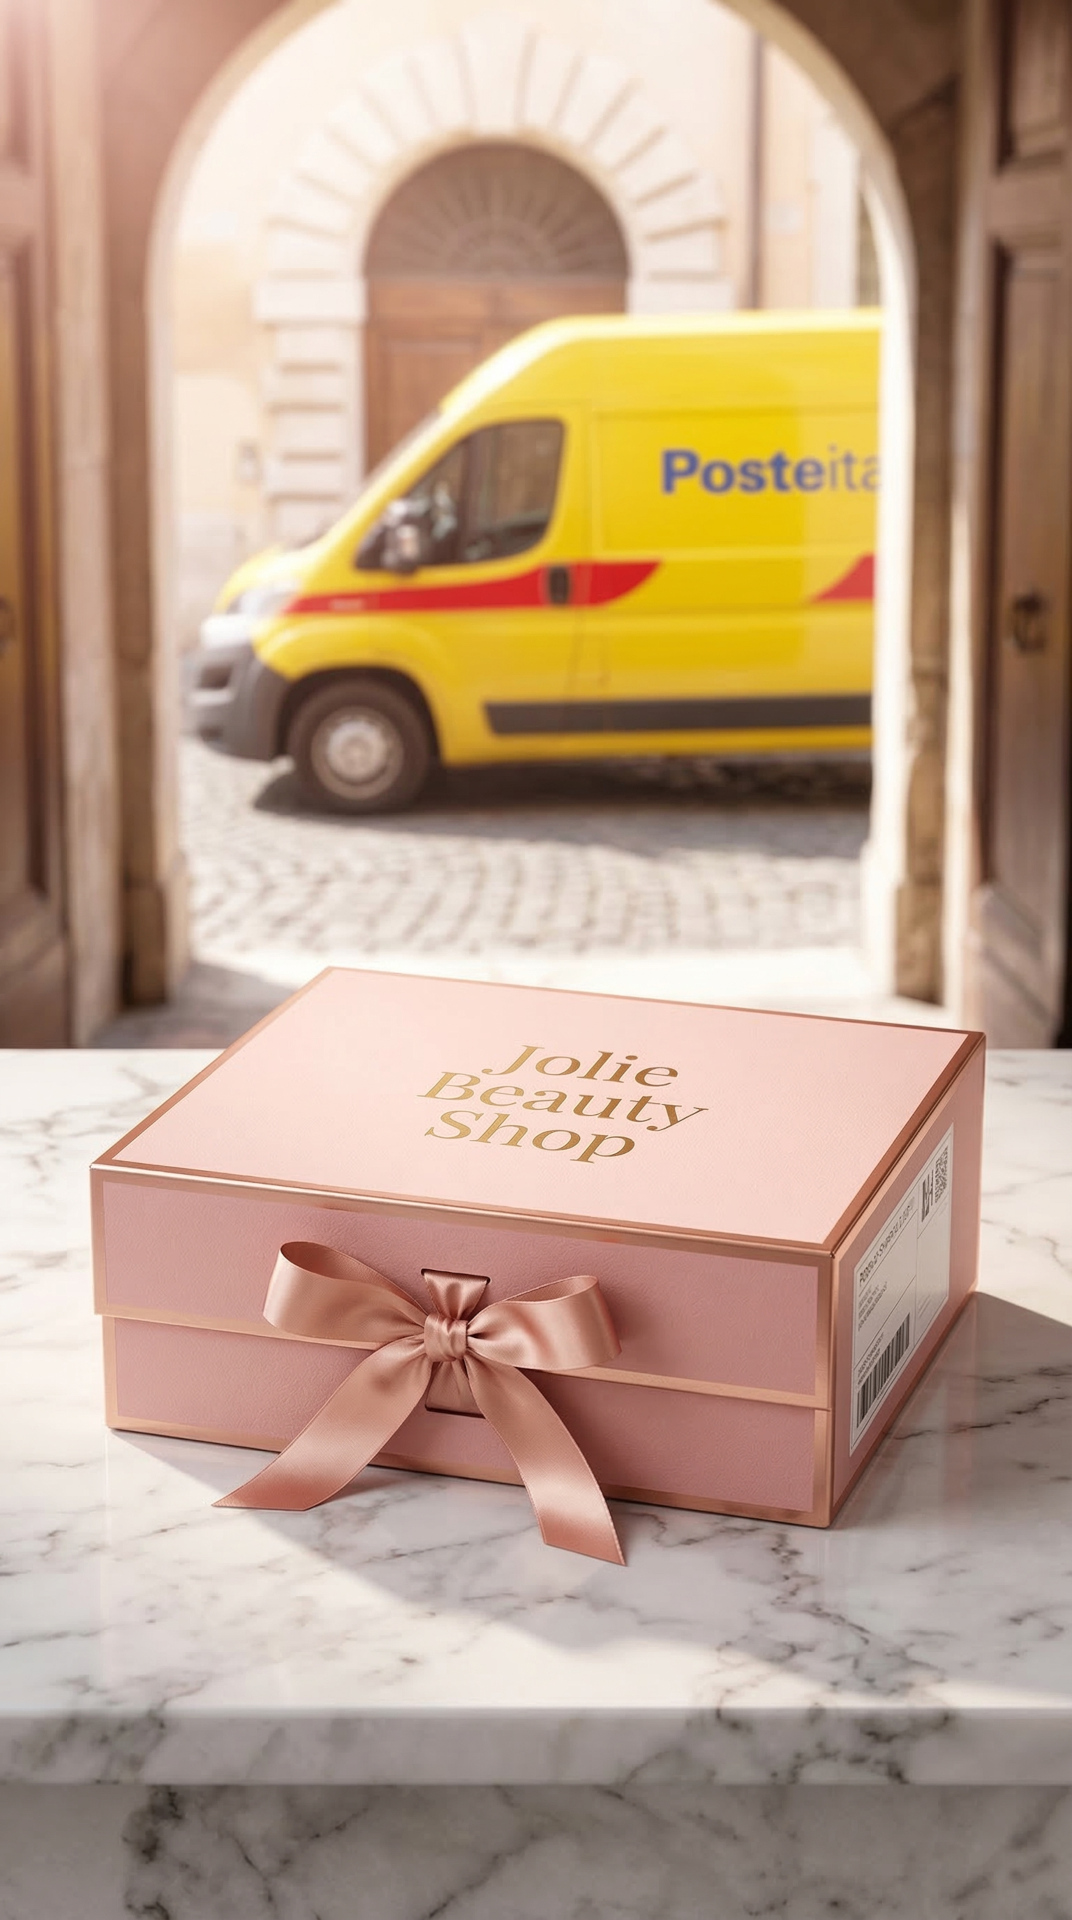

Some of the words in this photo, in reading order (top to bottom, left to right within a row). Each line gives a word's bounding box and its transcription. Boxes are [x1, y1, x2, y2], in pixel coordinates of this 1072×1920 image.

[481, 1045, 679, 1087] Jolie
[416, 1071, 709, 1132] Beauty
[424, 1110, 636, 1164] Shop
